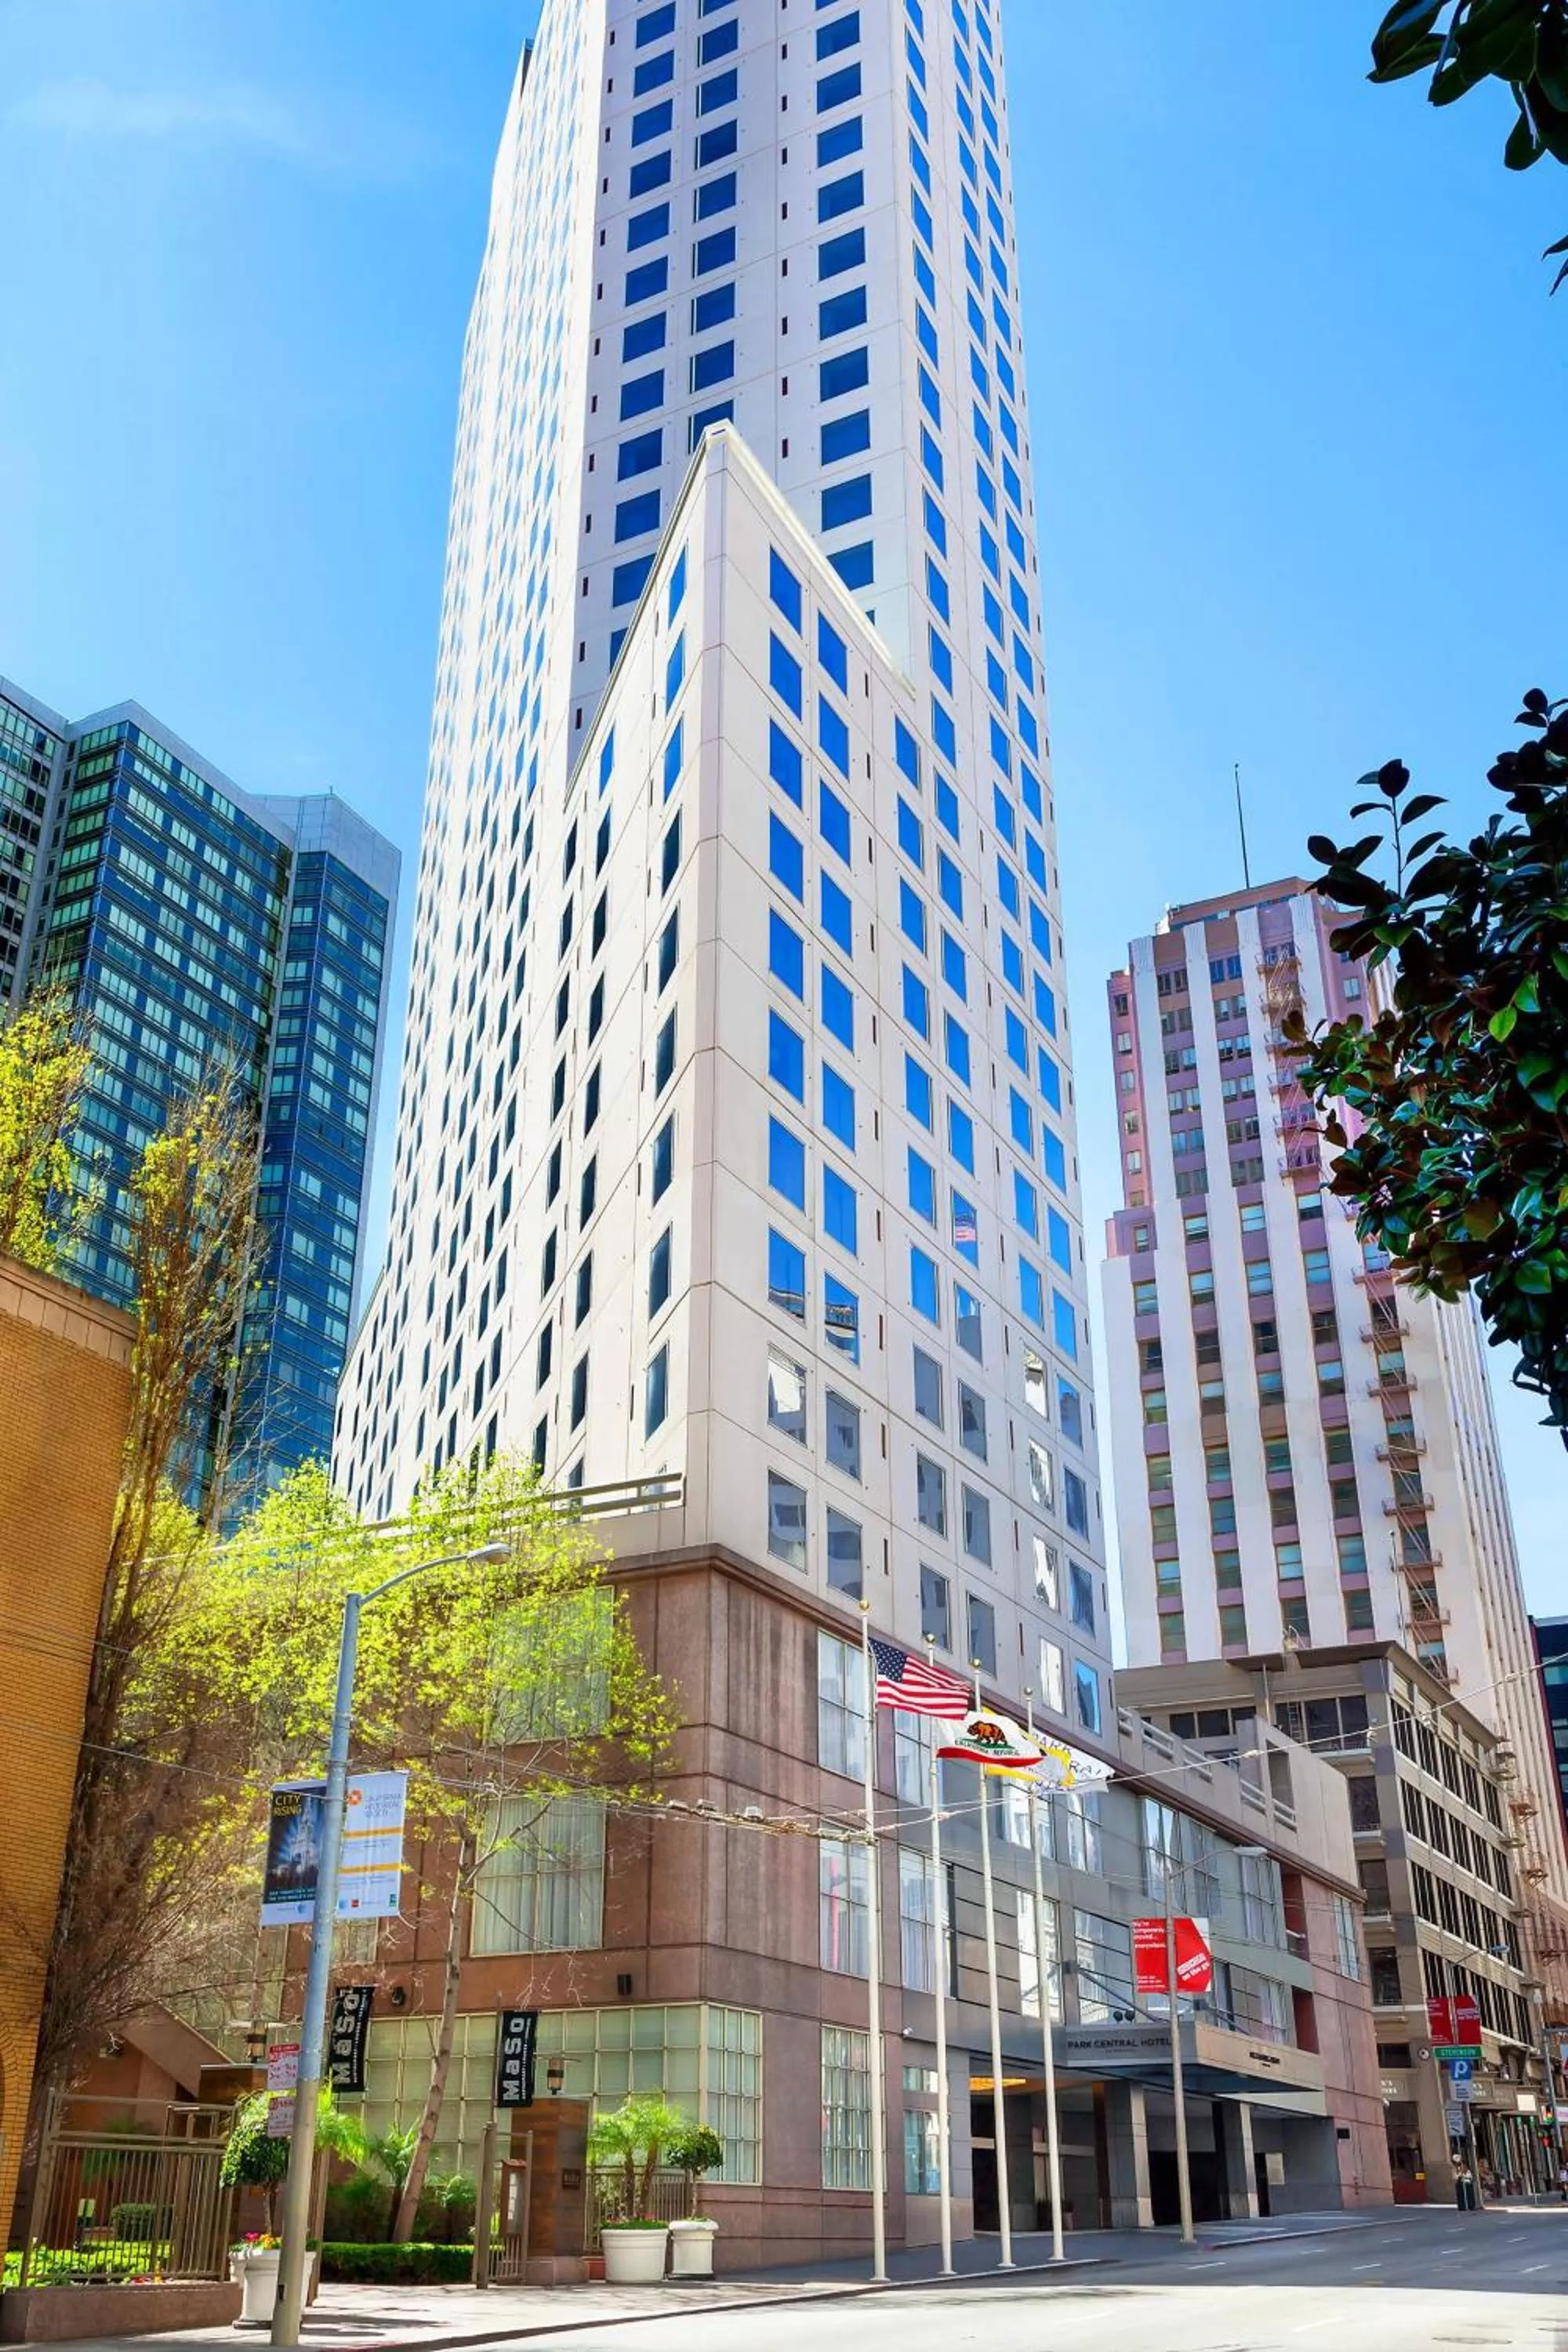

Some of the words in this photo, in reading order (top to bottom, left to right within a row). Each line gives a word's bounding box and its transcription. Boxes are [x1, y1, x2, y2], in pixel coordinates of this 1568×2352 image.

[275, 1795, 301, 1806] CITY
[274, 1805, 302, 1817] RISING
[1094, 2039, 1138, 2049] CENTRAL
[1140, 2038, 1172, 2048] HOTEL
